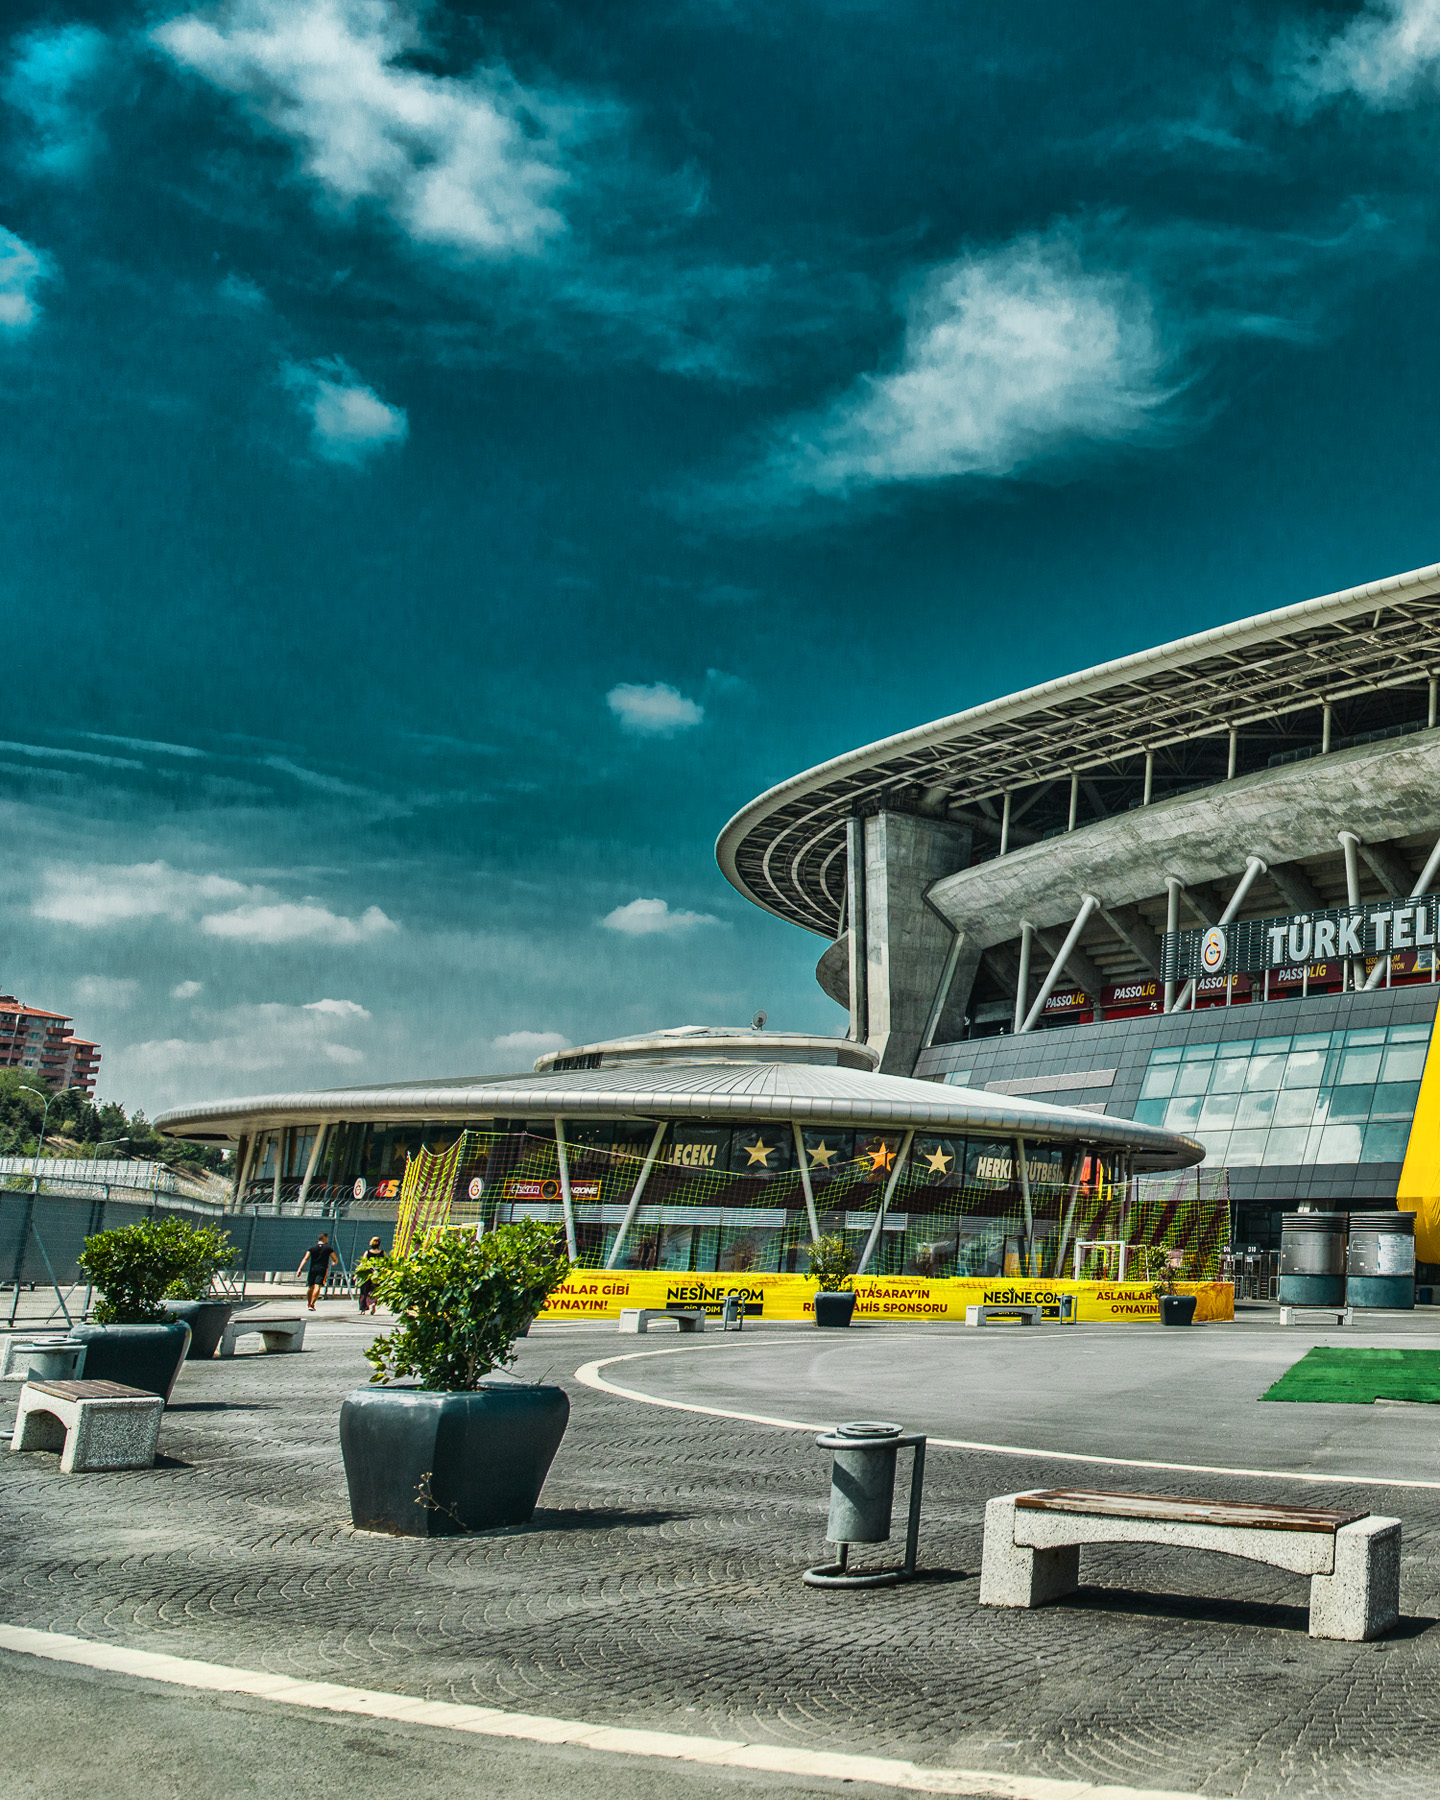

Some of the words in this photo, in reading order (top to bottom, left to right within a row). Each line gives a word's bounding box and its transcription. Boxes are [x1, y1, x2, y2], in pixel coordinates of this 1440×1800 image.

[1268, 915, 1364, 964] TÜRK
[602, 1283, 630, 1296] GİBİ
[1096, 1291, 1153, 1301] ASLANLAR
[854, 1301, 880, 1312] AHİS
[882, 1303, 948, 1313] SPONSORU
